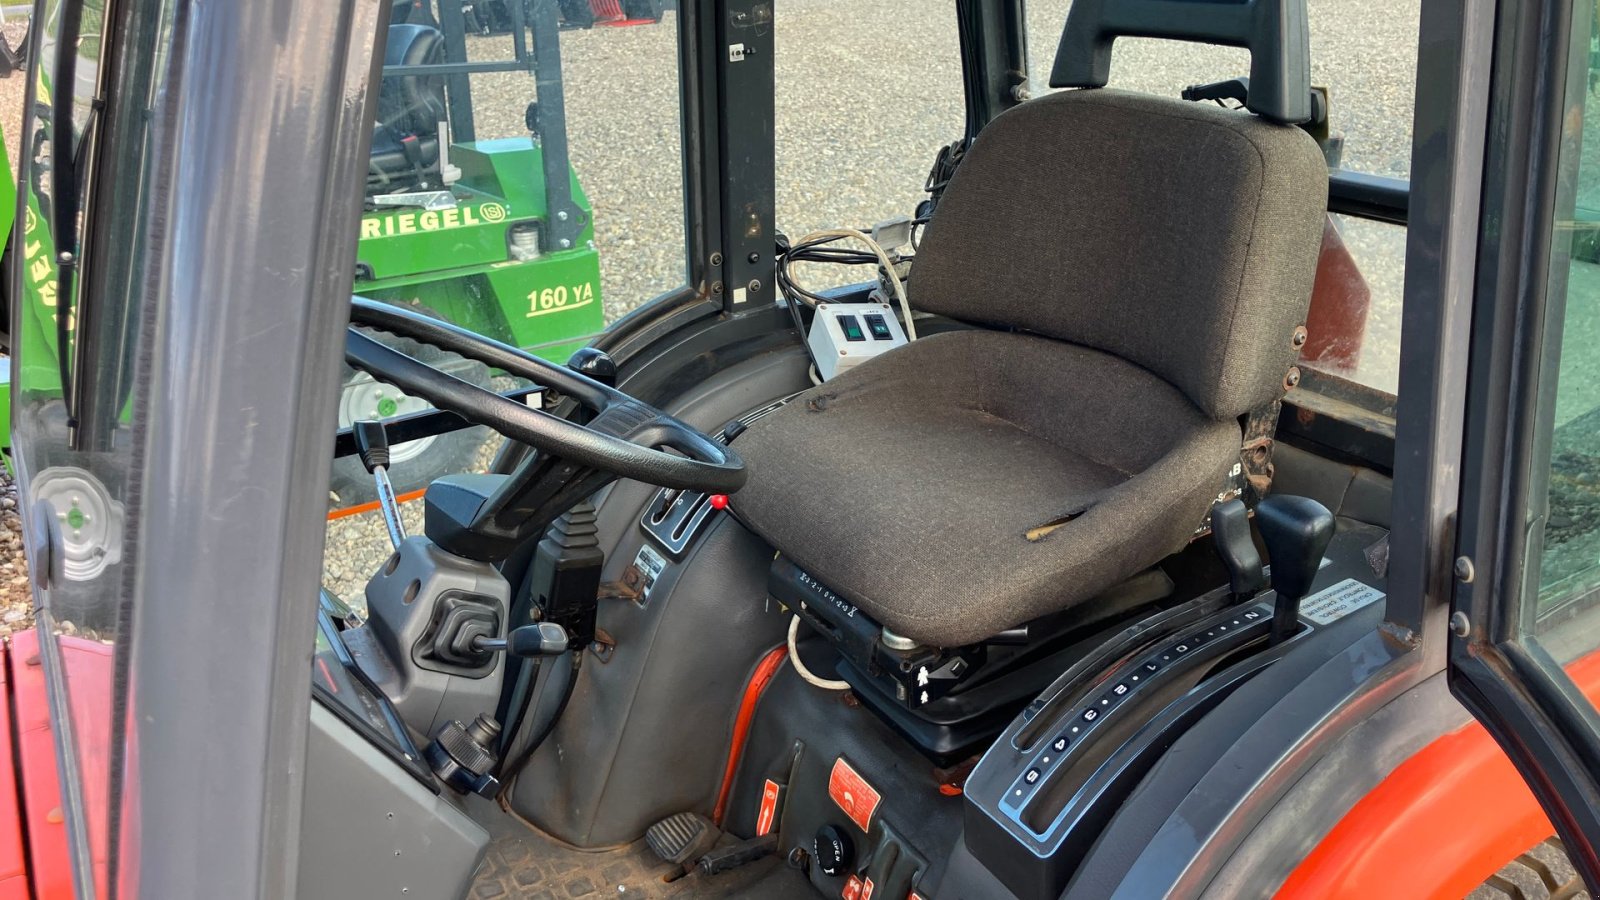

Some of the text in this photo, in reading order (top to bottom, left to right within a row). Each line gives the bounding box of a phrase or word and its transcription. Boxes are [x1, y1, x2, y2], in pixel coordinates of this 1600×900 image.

[526, 282, 593, 311] 160 YA
[1244, 611, 1259, 620] N
[1319, 604, 1347, 618] CONTROL
[1114, 684, 1128, 695] 2
[1084, 710, 1098, 721] 3
[1053, 738, 1066, 751] 4
[1026, 770, 1039, 782] 5
[832, 840, 841, 862] OPEN
